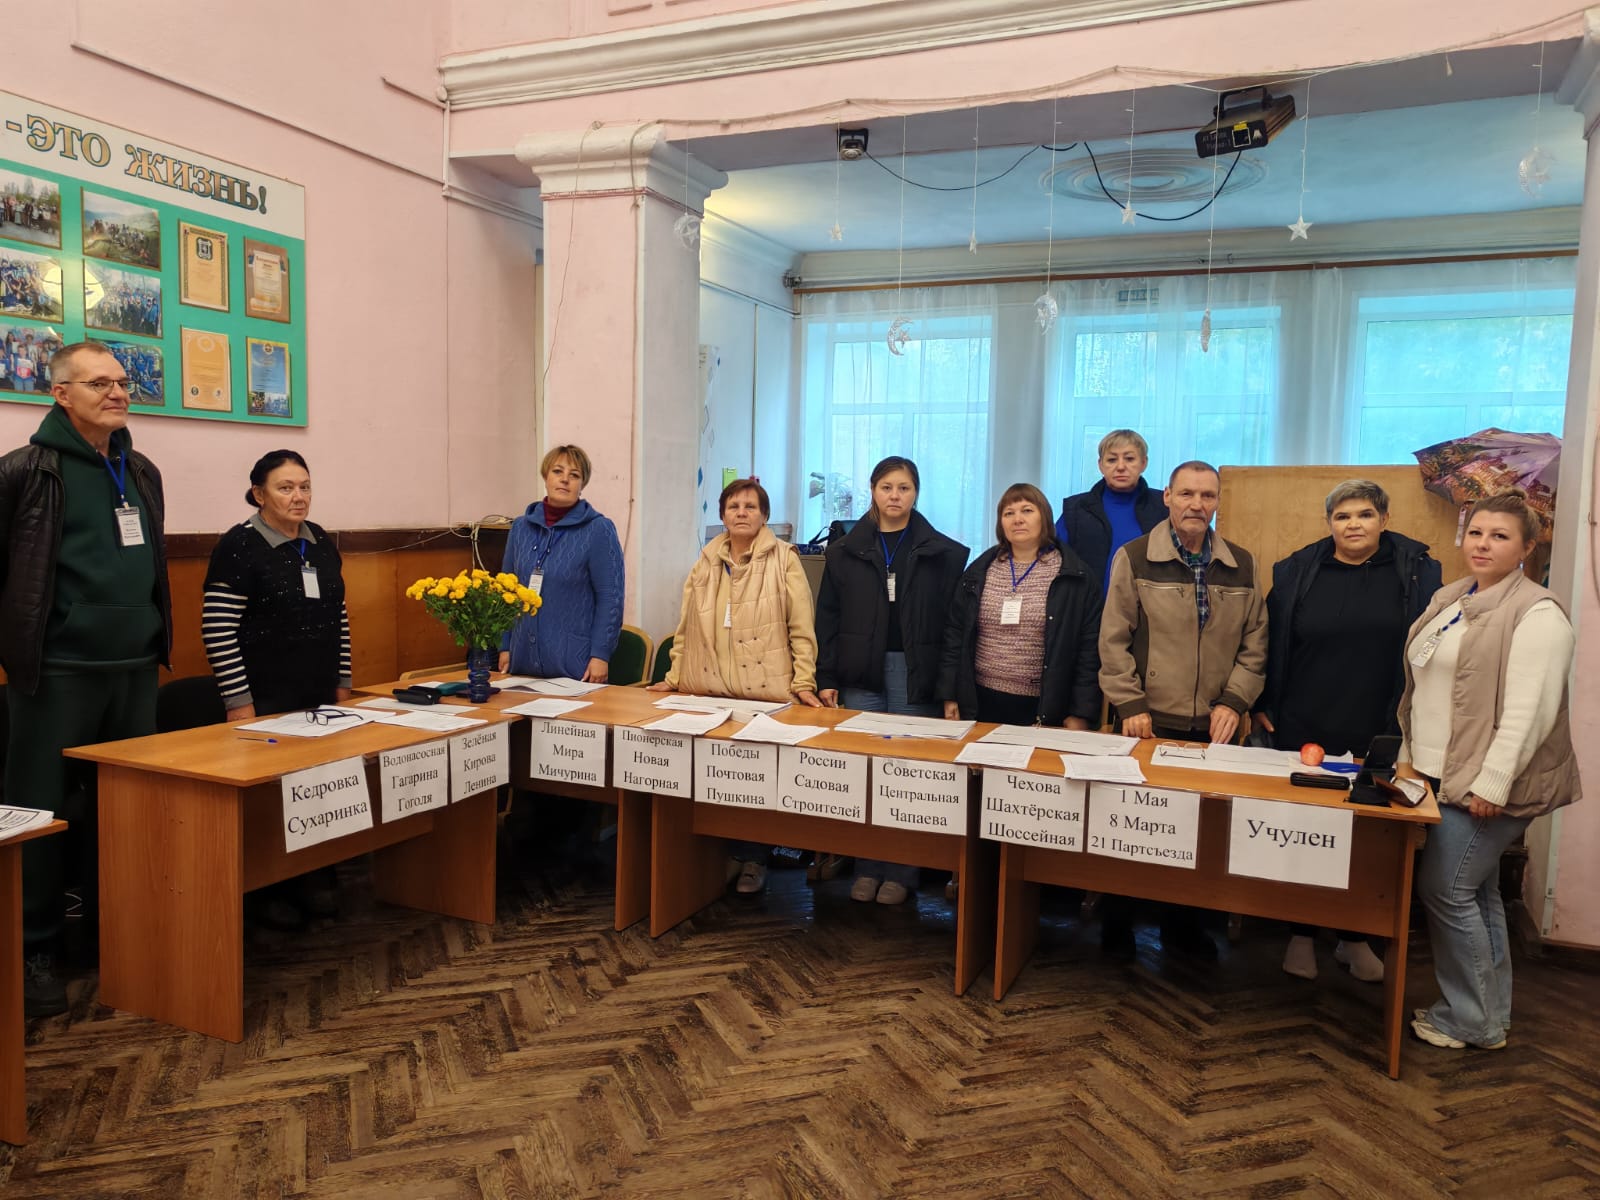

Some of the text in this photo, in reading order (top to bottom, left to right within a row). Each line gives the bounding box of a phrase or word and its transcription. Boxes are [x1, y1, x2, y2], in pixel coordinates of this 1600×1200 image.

[124, 144, 268, 215] ЖИЗНЬ!
[462, 730, 497, 750] Зелёная
[541, 721, 597, 739] Линейная
[622, 729, 684, 749] Пионерская
[383, 744, 446, 769] Водонасосная
[553, 744, 584, 760] Мира
[633, 751, 670, 768] Новая
[711, 743, 760, 760] Победы
[799, 751, 847, 770] России
[463, 753, 497, 772] Кирова
[882, 762, 956, 782] Советская
[392, 769, 439, 790] Гагарина
[538, 764, 597, 783] Мичурина
[623, 772, 679, 791] Нагорная
[706, 765, 765, 783] Почтовая
[794, 774, 850, 793] Садовая
[290, 773, 360, 803] Кедровка
[463, 773, 497, 795] Ленина
[1006, 774, 1062, 795] Чехова
[397, 792, 433, 812] Гоголя
[706, 787, 765, 806] Пушкина
[879, 784, 960, 805] Центральная
[1121, 789, 1169, 809] 1 Мая
[782, 795, 861, 819] Строителей
[890, 807, 948, 827] Чапаева
[986, 796, 1080, 823] Шахтёрская
[287, 801, 368, 835] Сухаринка
[1109, 813, 1177, 836] 8 Марта
[988, 821, 1076, 847] Шоссейная
[1246, 818, 1336, 850] Учулен
[1091, 835, 1194, 862] 21 Партсъезда
